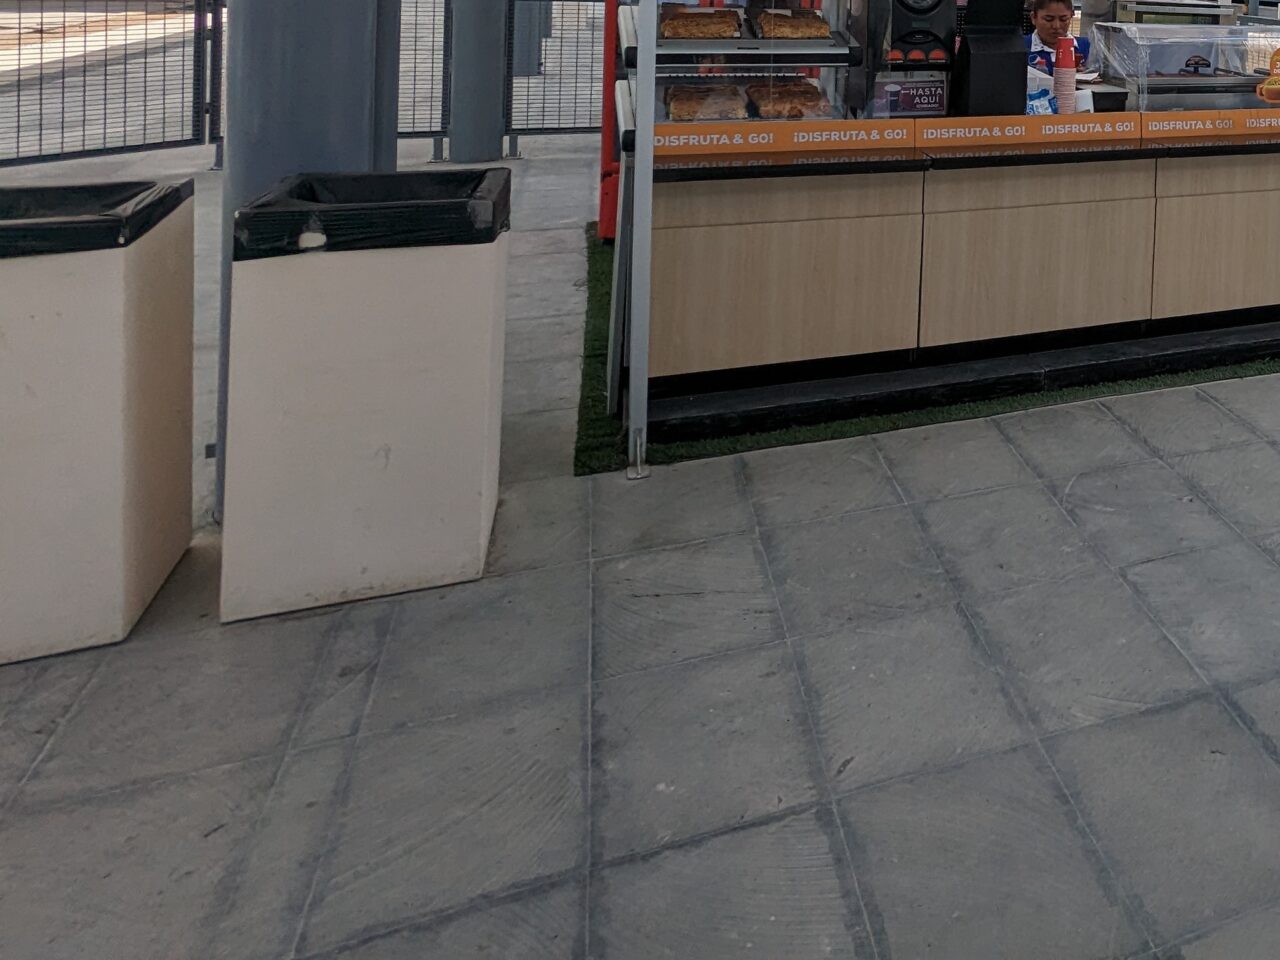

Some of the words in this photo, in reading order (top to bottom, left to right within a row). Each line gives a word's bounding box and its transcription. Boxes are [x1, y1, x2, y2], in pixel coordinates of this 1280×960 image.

[910, 87, 943, 95] HASTA
[914, 94, 940, 104] AQUÍ
[1042, 123, 1102, 134] ¡DISFRUTA
[1103, 122, 1113, 132] &
[1116, 122, 1134, 132] GO!
[1149, 121, 1203, 131] ¡DISFRUTA
[1205, 120, 1213, 129] &
[1215, 120, 1233, 129] GO!
[793, 131, 868, 143] ¡DISFRUTA
[869, 130, 880, 140] &
[884, 129, 907, 139] GO!
[923, 127, 990, 139] ¡DISFRUTA
[992, 127, 1001, 137] &
[1005, 126, 1025, 136] GO!
[654, 134, 729, 146] DISFRUTA
[733, 133, 744, 144] &
[748, 132, 774, 144] GO!
